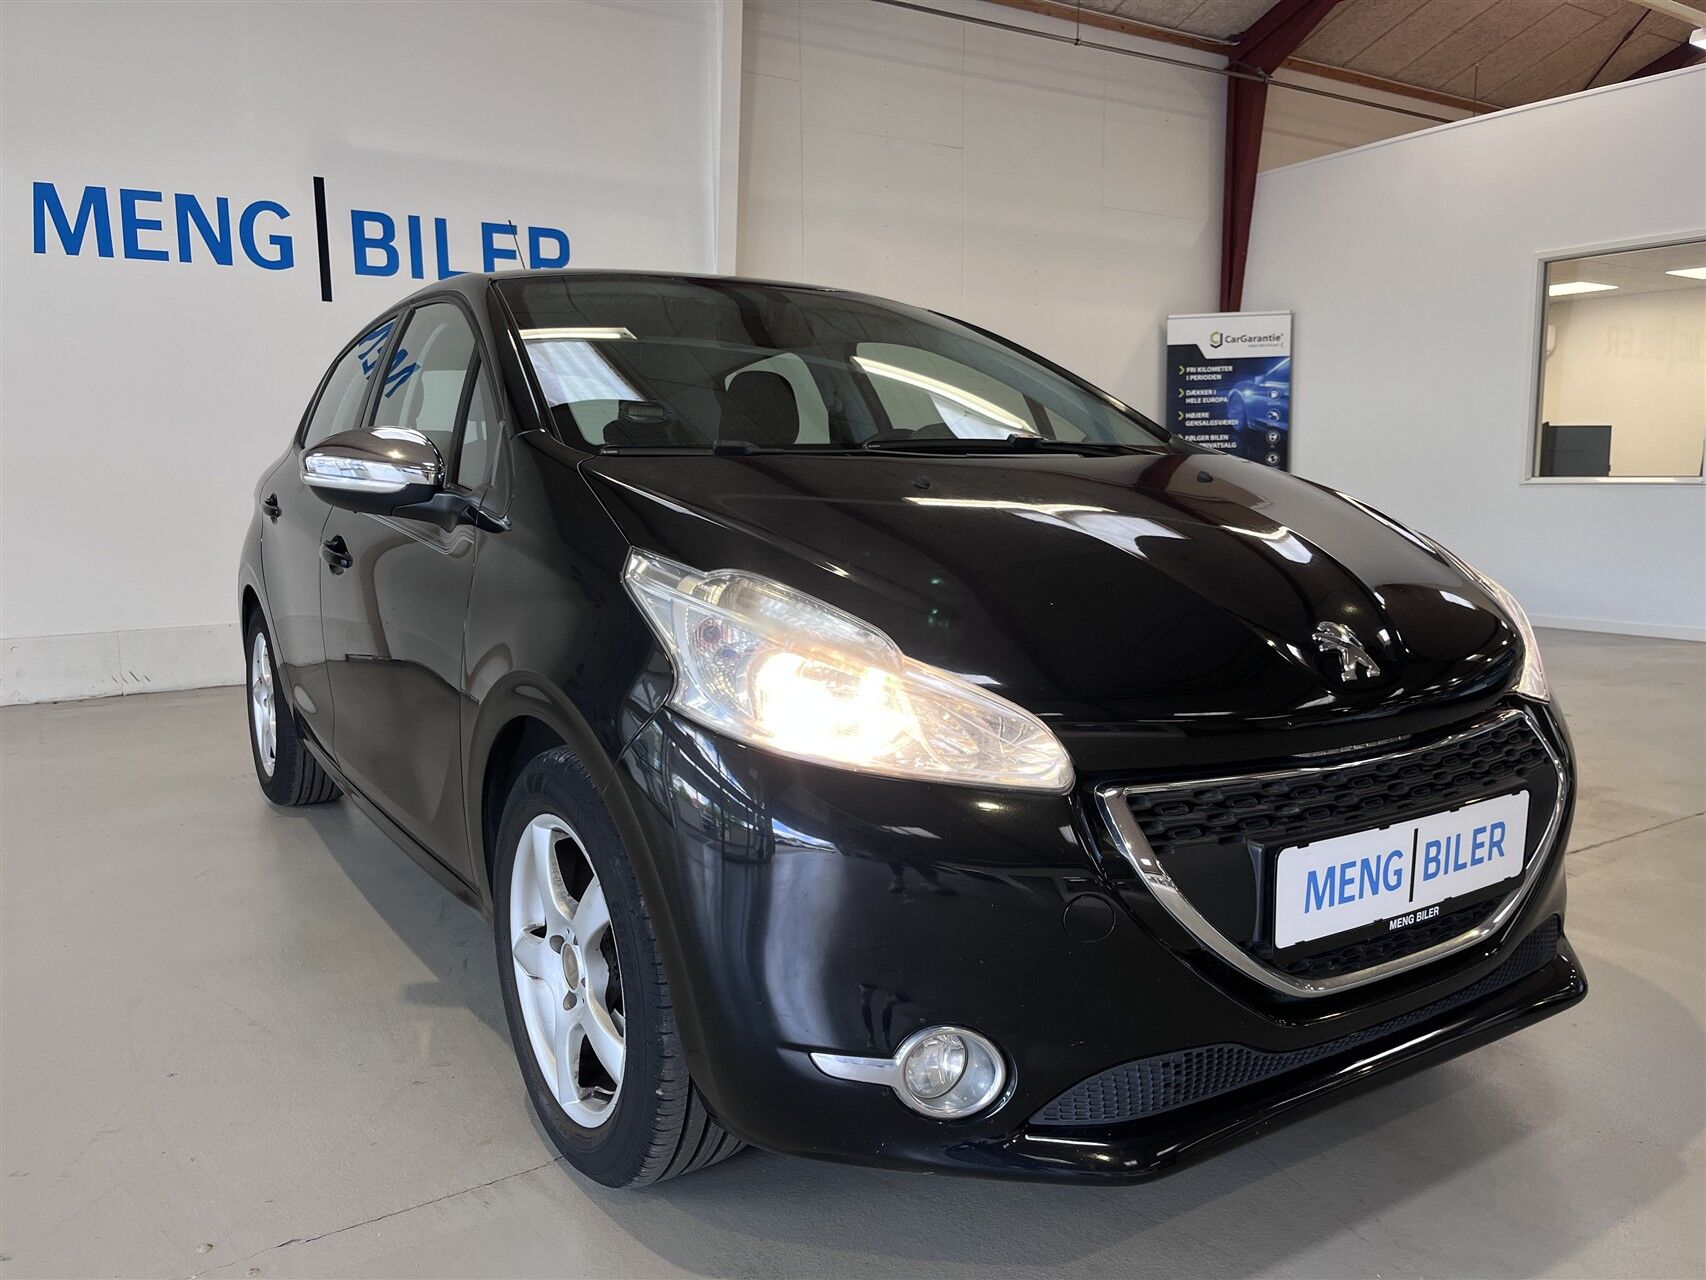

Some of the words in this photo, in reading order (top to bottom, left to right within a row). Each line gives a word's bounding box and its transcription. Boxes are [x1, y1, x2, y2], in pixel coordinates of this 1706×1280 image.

[32, 181, 295, 270] MENG
[350, 209, 571, 281] BILER
[1225, 334, 1281, 344] CarGarantie
[1197, 365, 1233, 373] KILOMETER
[1304, 850, 1404, 914] MENG
[1422, 821, 1506, 882] BILER
[1389, 914, 1415, 931] MENG
[1416, 906, 1440, 922] BILER
